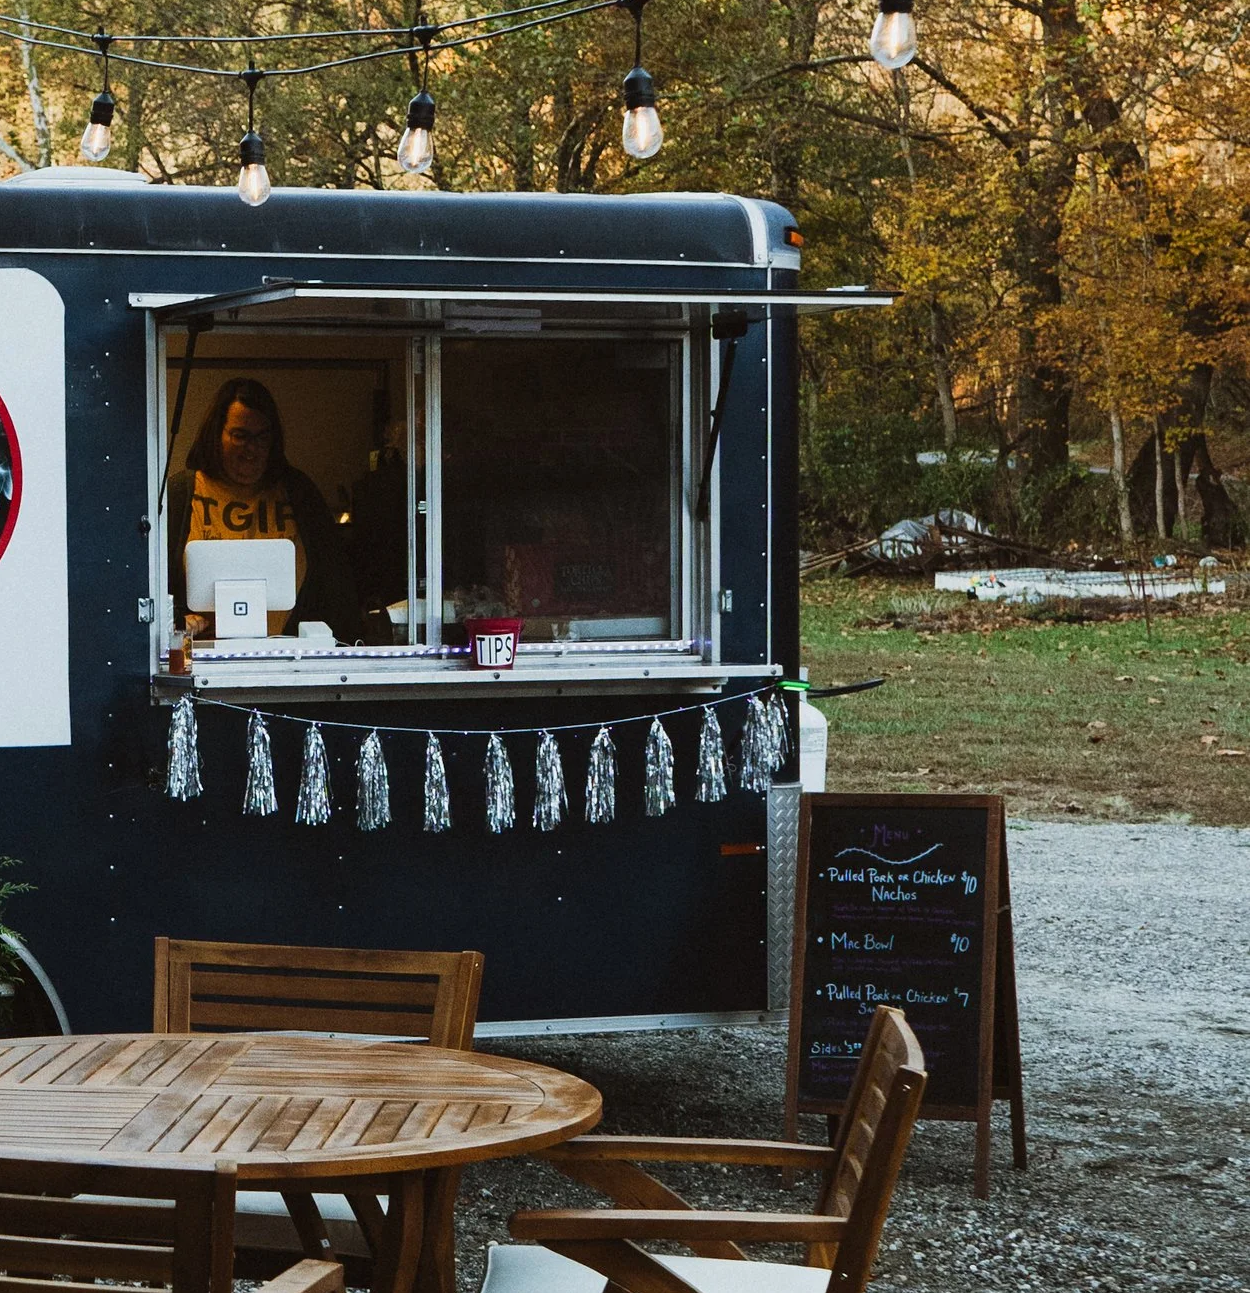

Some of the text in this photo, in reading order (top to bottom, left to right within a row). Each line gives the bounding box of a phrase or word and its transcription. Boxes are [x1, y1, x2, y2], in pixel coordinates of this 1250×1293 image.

[476, 636, 513, 664] TIPS
[829, 867, 865, 883] Pulled
[960, 870, 978, 895] $10
[950, 932, 970, 954] $10
[826, 983, 862, 1001] Pulled
